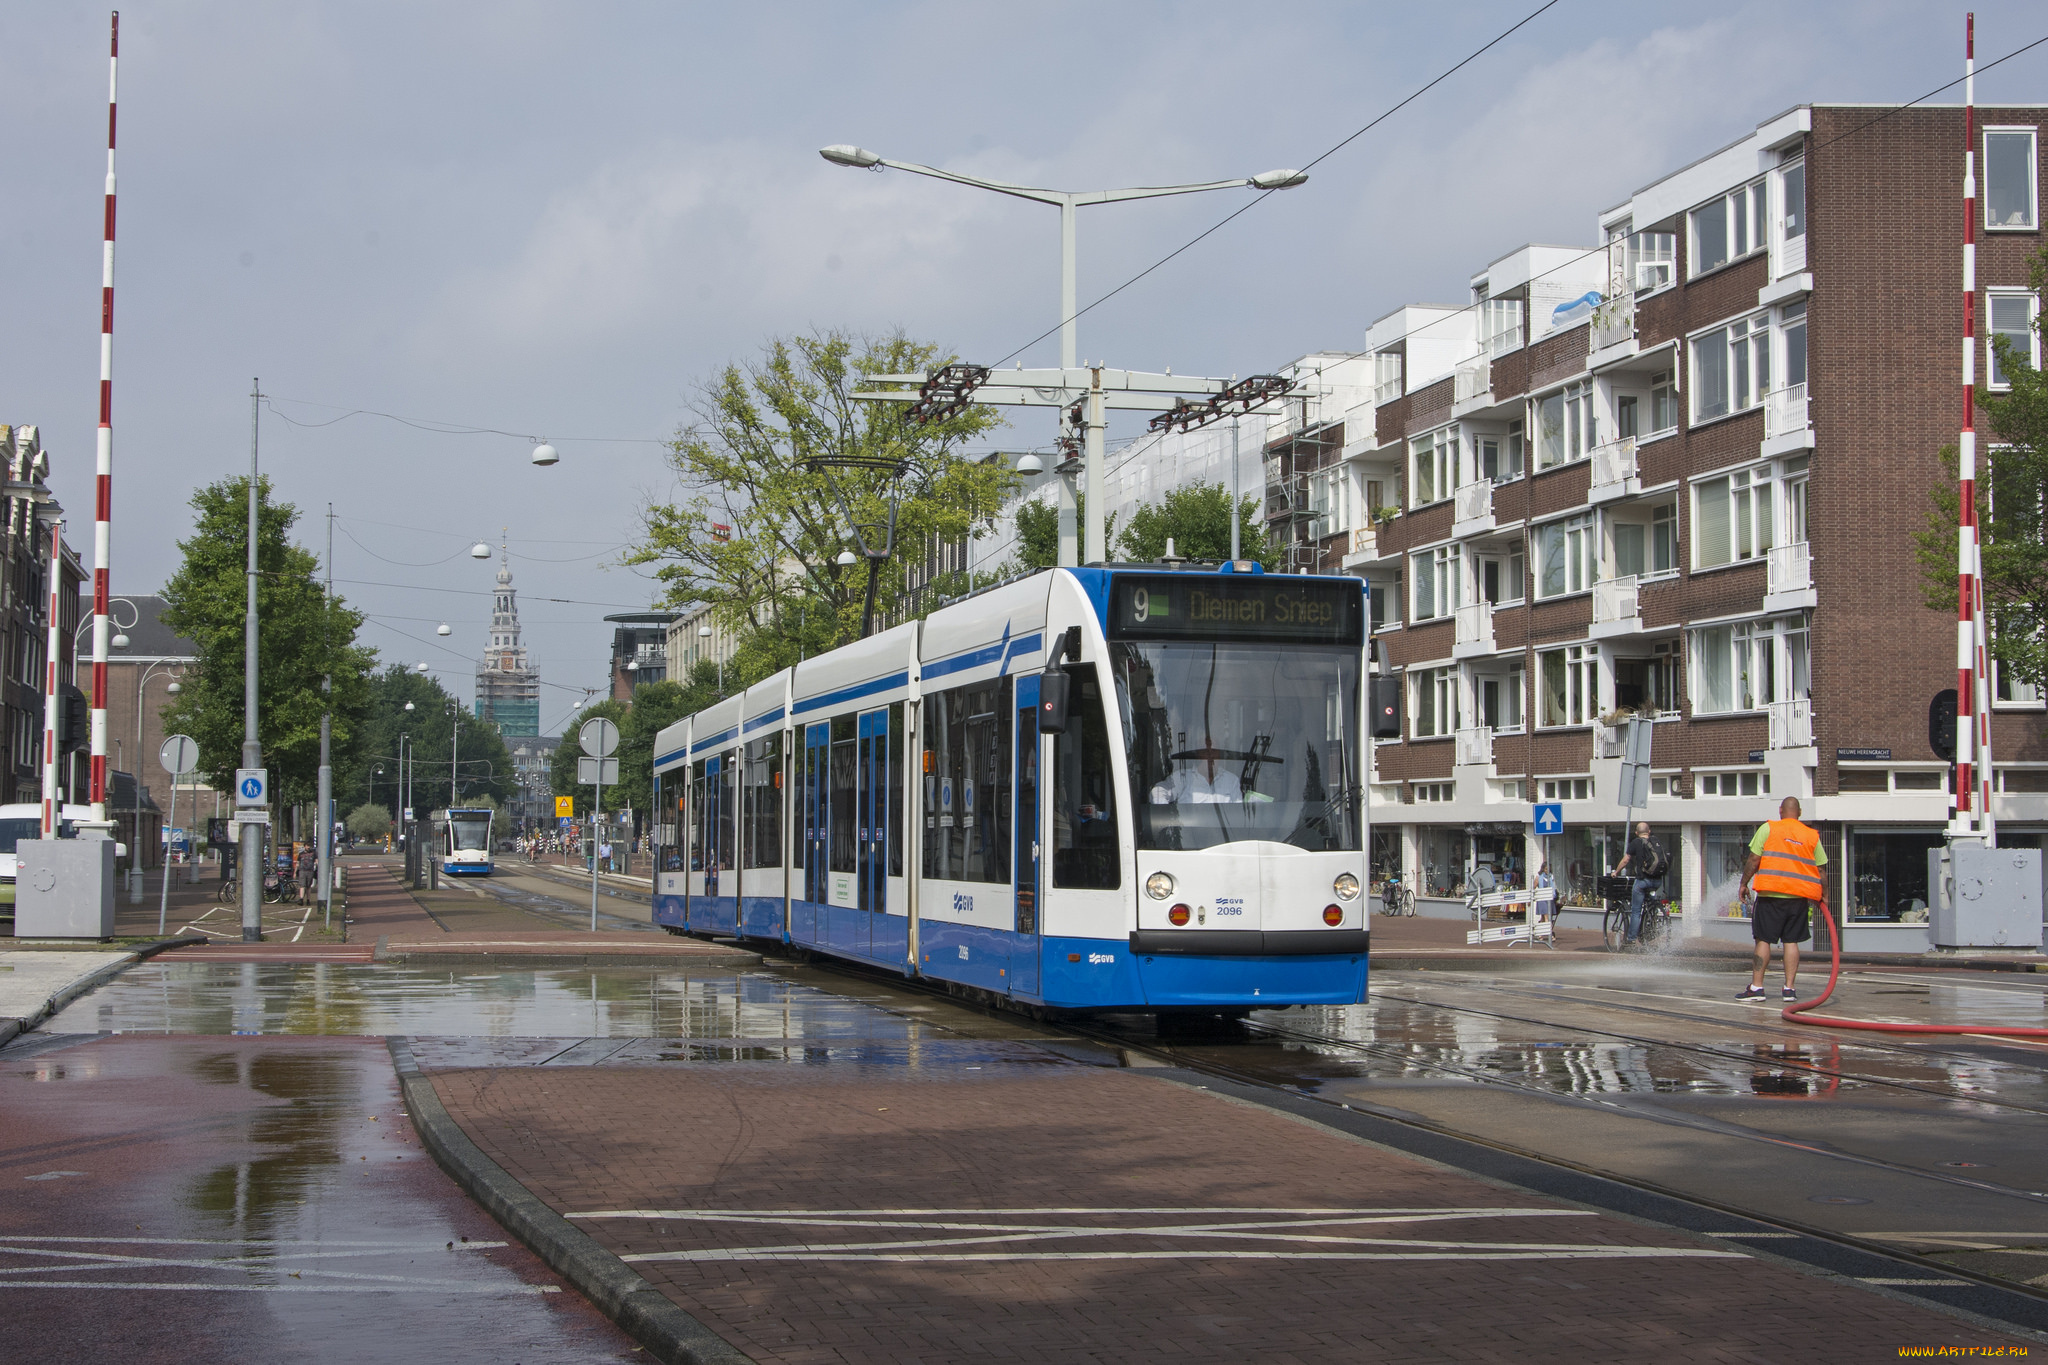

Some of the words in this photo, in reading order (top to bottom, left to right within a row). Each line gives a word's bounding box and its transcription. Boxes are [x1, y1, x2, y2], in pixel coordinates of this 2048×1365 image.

[1134, 587, 1149, 623] 9
[1190, 590, 1265, 622] Diemen
[1274, 593, 1333, 626] Sniep
[962, 895, 973, 911] GVB
[1217, 906, 1242, 916] 2096
[1101, 954, 1115, 963] GVB
